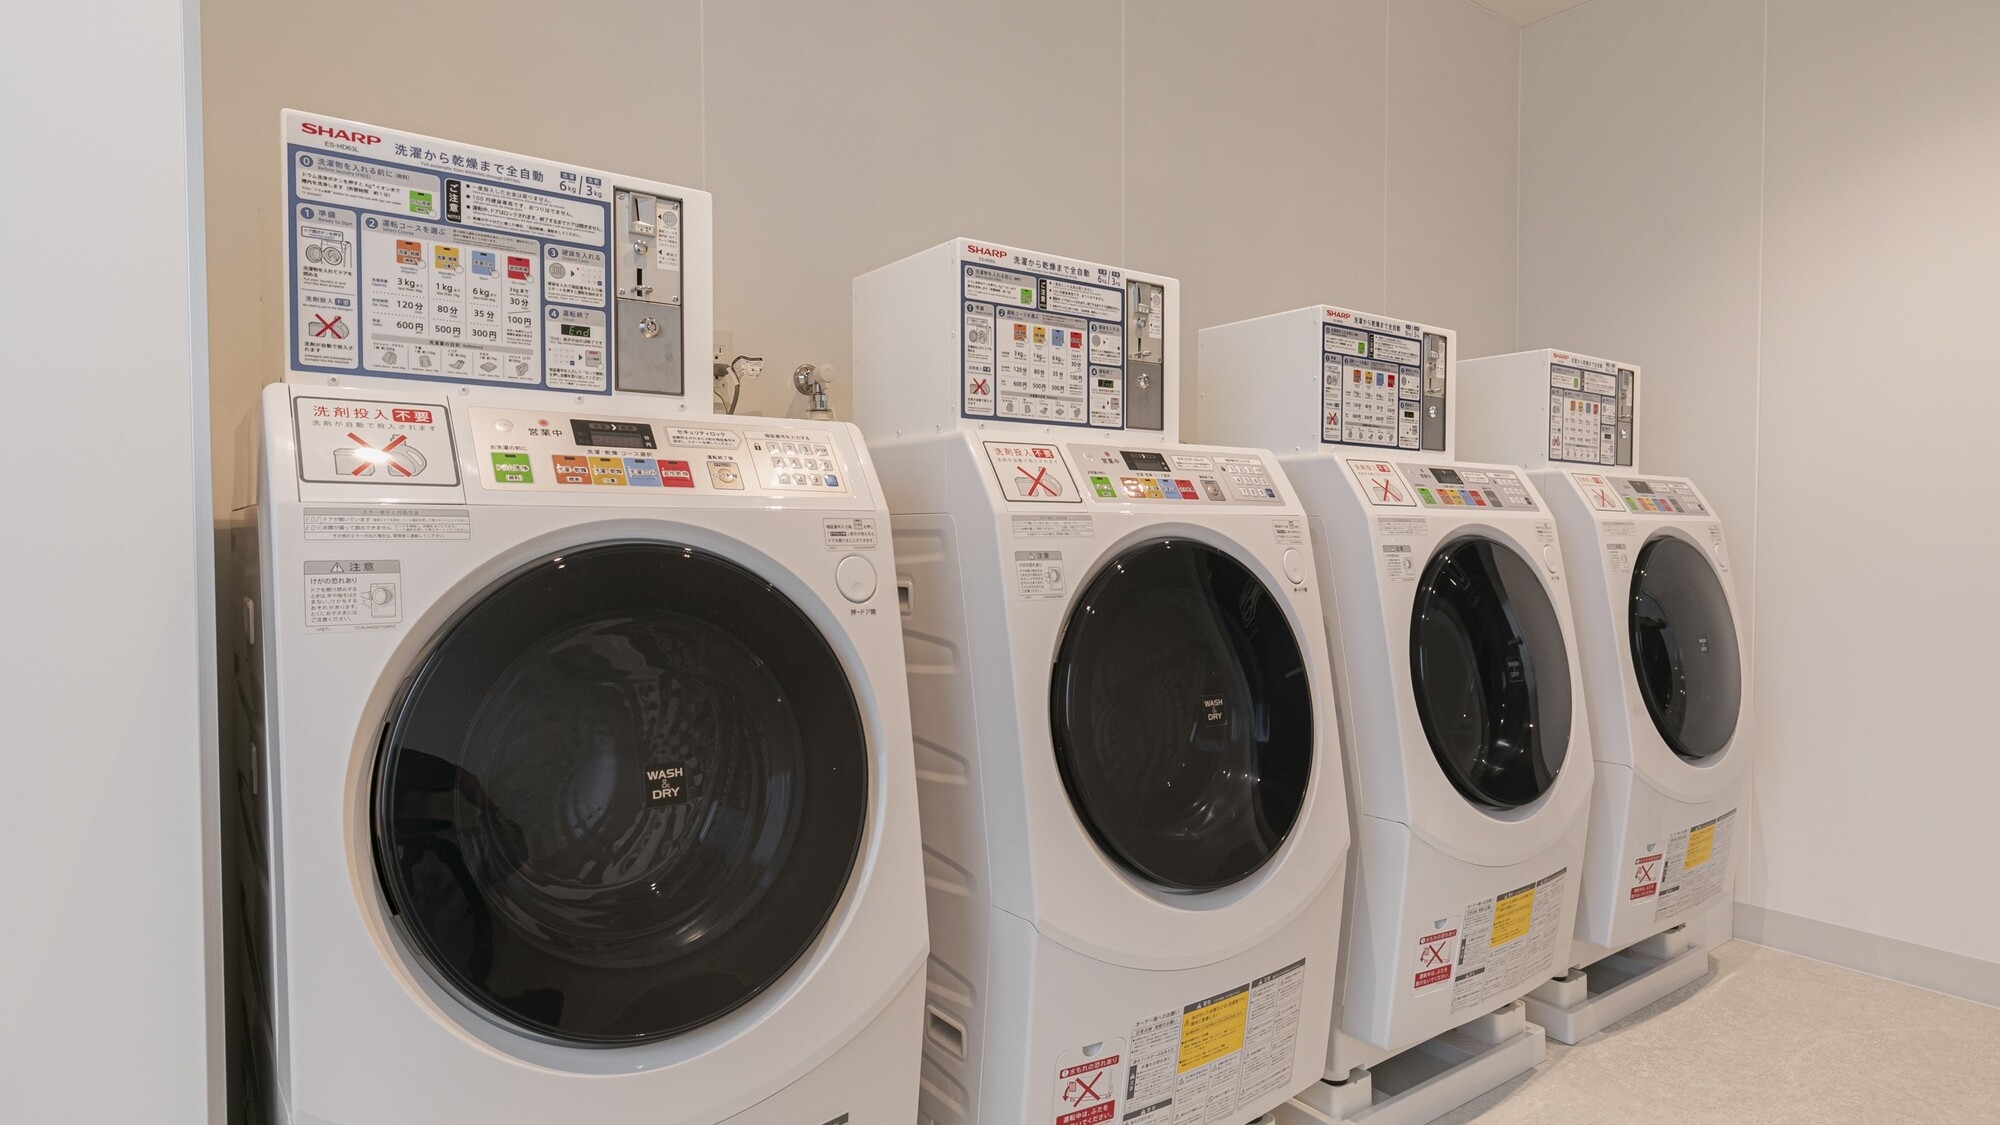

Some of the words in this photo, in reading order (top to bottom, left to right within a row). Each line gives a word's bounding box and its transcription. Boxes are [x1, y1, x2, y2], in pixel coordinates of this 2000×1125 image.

[301, 122, 382, 145] SHARP
[317, 158, 393, 178] 洗濯物を入れる前に
[394, 143, 544, 183] 洗濯から乾燥まで全自動
[448, 183, 460, 213] ご注意
[318, 210, 336, 219] 準備
[382, 219, 446, 236] 運転コースを選ぶ
[561, 249, 601, 261] 硬貨を入れる
[967, 244, 1008, 259] SHARP
[1013, 255, 1090, 278] 洗濯から乾燥まで全自動
[397, 300, 423, 311] 120分
[510, 297, 529, 307] 30分
[437, 305, 458, 315] 80分
[474, 309, 494, 319] 35分
[562, 310, 590, 319] 運転終了
[1326, 309, 1351, 319] SHARP
[396, 321, 424, 332] 600円
[507, 316, 532, 327] 100円
[435, 325, 461, 336] 500円
[472, 329, 497, 339] 300円
[569, 325, 590, 337] End
[312, 404, 389, 420] 洗剤投入
[395, 409, 431, 423] 不要
[312, 419, 436, 432] 洗剤が自動で投入されます
[527, 427, 563, 437] 営業中
[677, 429, 725, 437] セキュリティロック
[349, 562, 375, 572] 注意
[310, 577, 358, 585] けがの恐れあり
[1203, 698, 1223, 708] WASH
[1207, 712, 1222, 721] DRY
[646, 767, 684, 781] WASH
[661, 778, 671, 789] &
[652, 786, 680, 800] DRY
[1069, 1057, 1119, 1076] 水もれの恐れあり
[1063, 1104, 1109, 1124] 運転中は、ふたを
